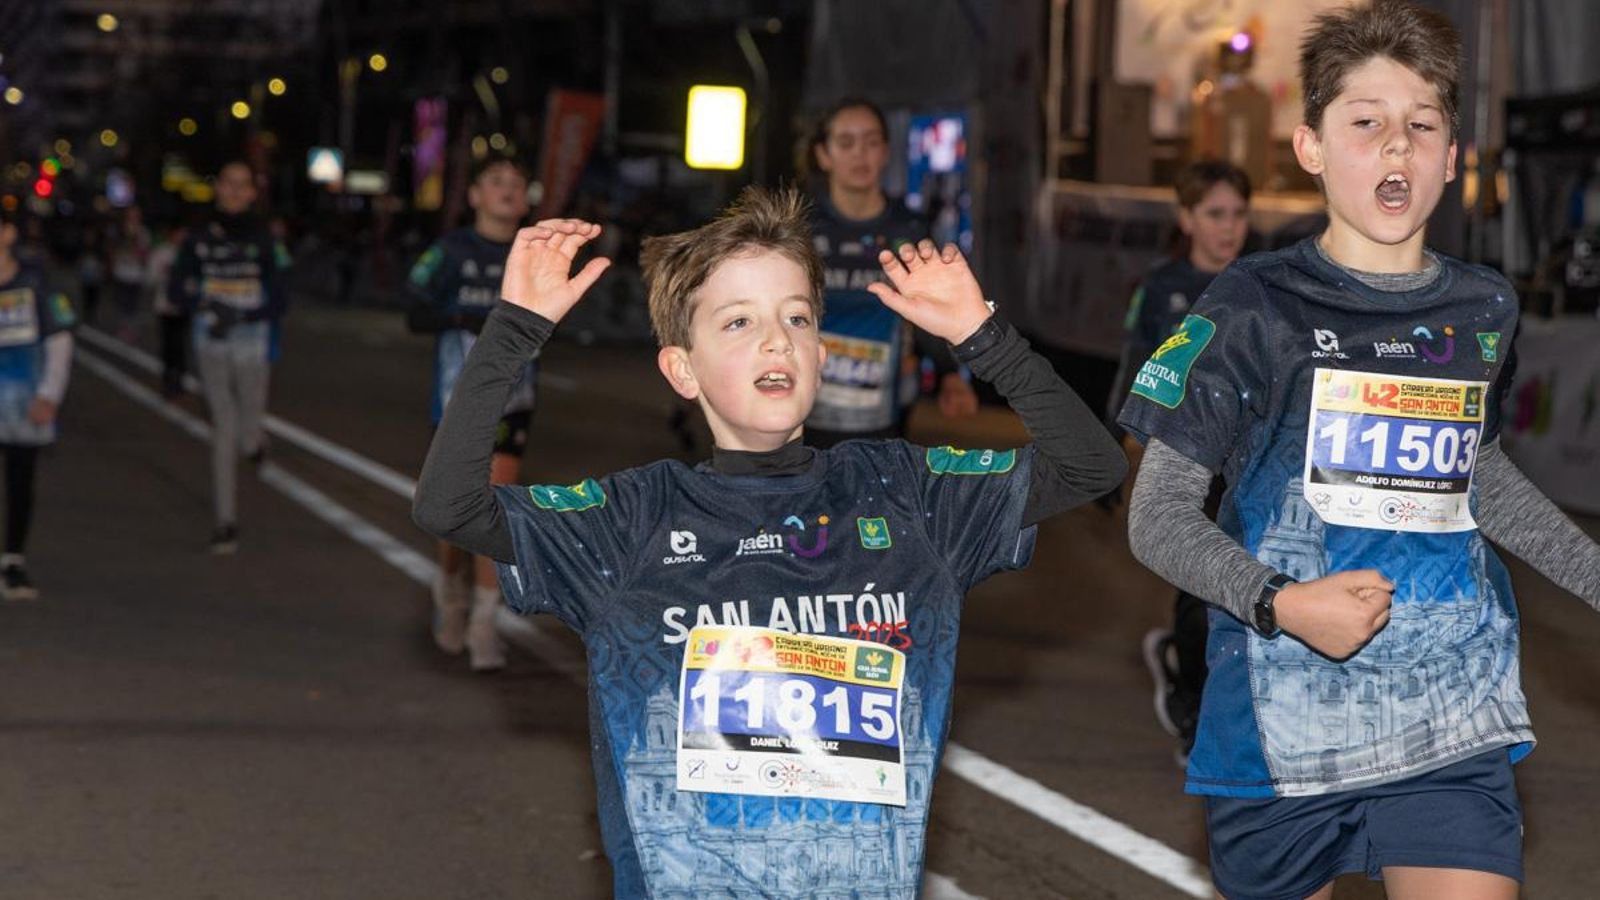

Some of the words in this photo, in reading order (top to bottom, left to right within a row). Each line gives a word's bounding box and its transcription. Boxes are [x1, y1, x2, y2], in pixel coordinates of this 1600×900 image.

[1363, 383, 1399, 409] 42
[1400, 398, 1423, 409] SAN
[1320, 418, 1478, 474] 11503
[1356, 475, 1389, 486] ADOLFO
[1391, 478, 1436, 489] DOMÍNGUEZ
[735, 529, 783, 556] jaén
[663, 599, 750, 644] SAN
[768, 582, 906, 633] ANTÓN
[775, 652, 802, 664] SAN
[690, 674, 896, 741] 11815
[750, 736, 783, 748] DANIEL
